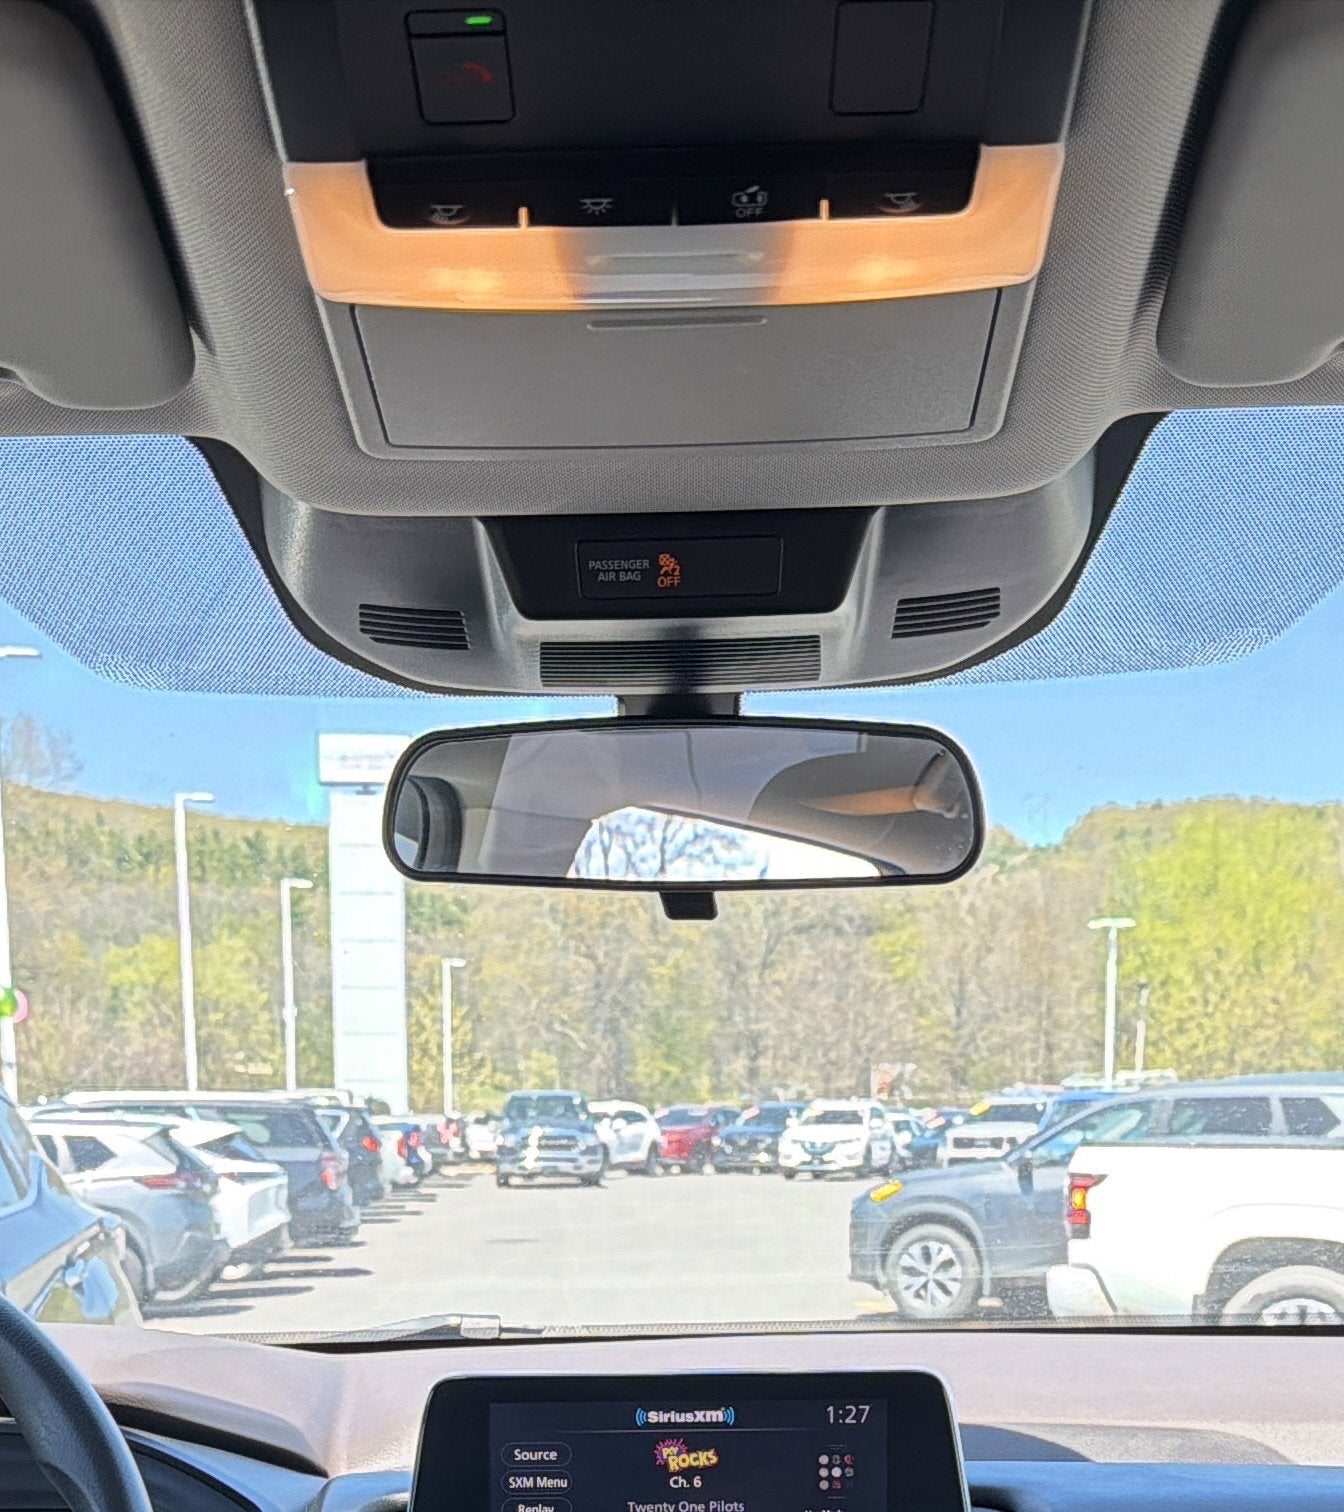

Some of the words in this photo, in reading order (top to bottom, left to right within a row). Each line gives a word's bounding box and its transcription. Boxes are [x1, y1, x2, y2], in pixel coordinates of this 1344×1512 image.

[735, 206, 767, 219] OFF
[588, 558, 651, 571] PASSENGER
[597, 571, 617, 582] AIR
[618, 571, 642, 582] BAG
[657, 576, 682, 588] OFF
[825, 1405, 873, 1425] 1:27
[513, 1448, 559, 1462] Source
[667, 1448, 720, 1473] ROCKS
[508, 1476, 535, 1489] SXM
[536, 1476, 569, 1489] Menu
[669, 1475, 691, 1489] Ch.
[693, 1476, 703, 1488] 6
[678, 1501, 706, 1512] One
[708, 1500, 745, 1512] Pilots
